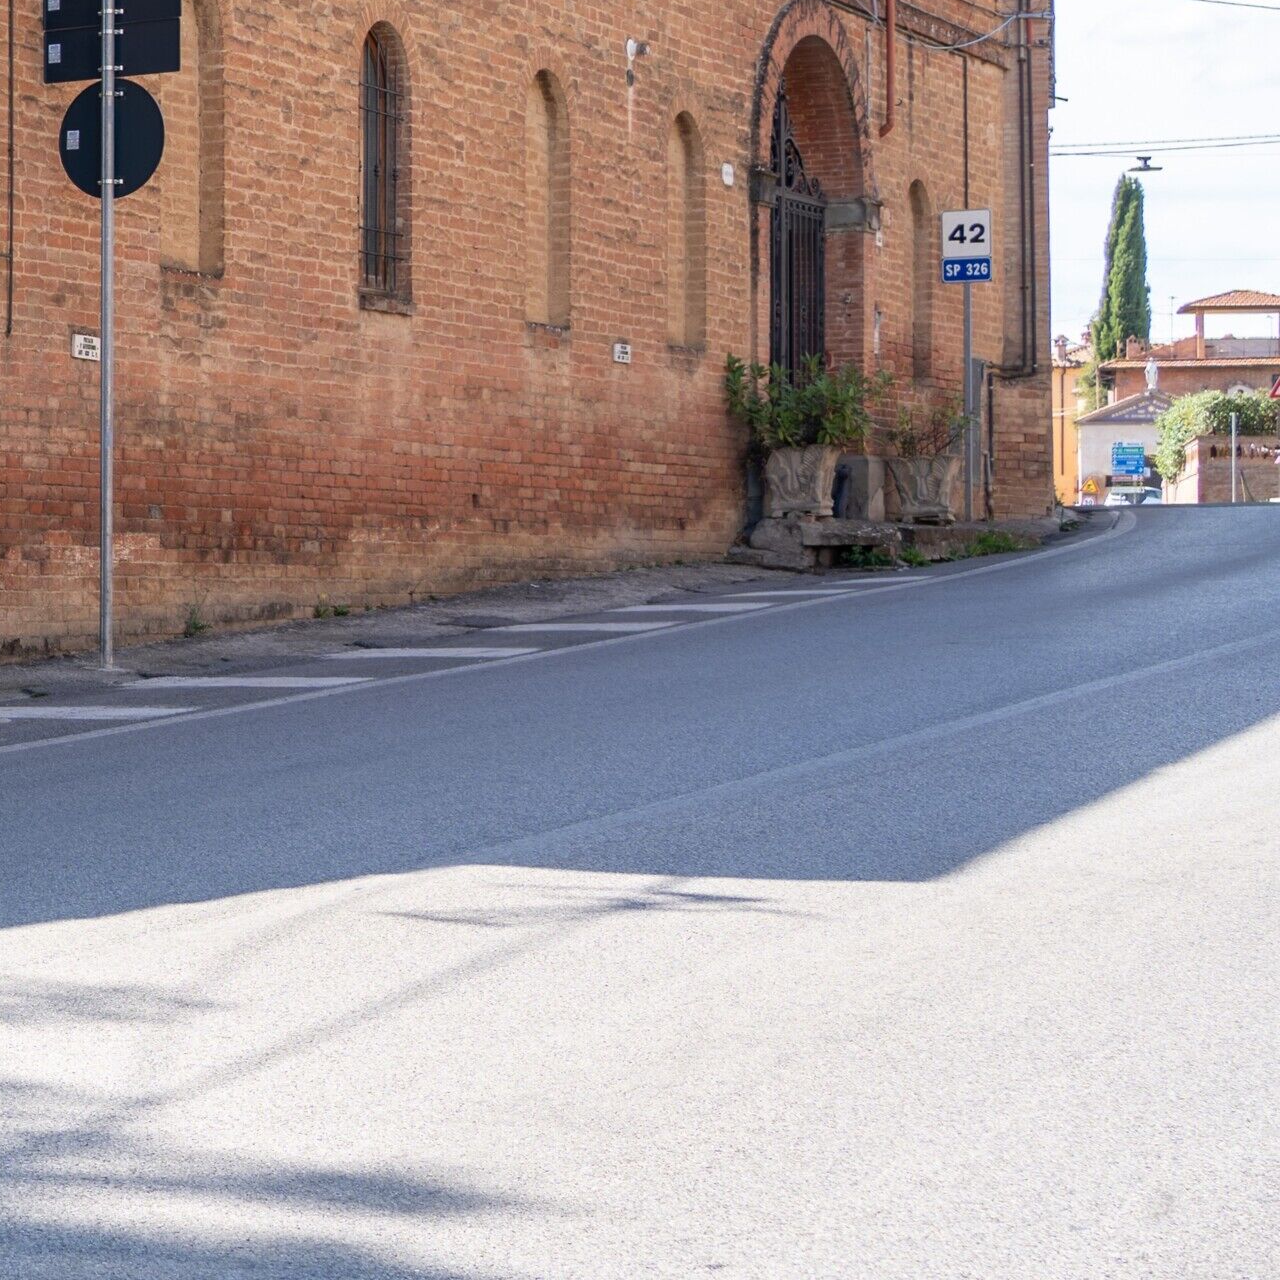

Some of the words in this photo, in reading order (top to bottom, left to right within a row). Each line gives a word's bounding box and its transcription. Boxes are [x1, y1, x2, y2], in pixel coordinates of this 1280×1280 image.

[948, 223, 985, 244] 42
[945, 263, 961, 277] SP
[966, 262, 988, 276] 326
